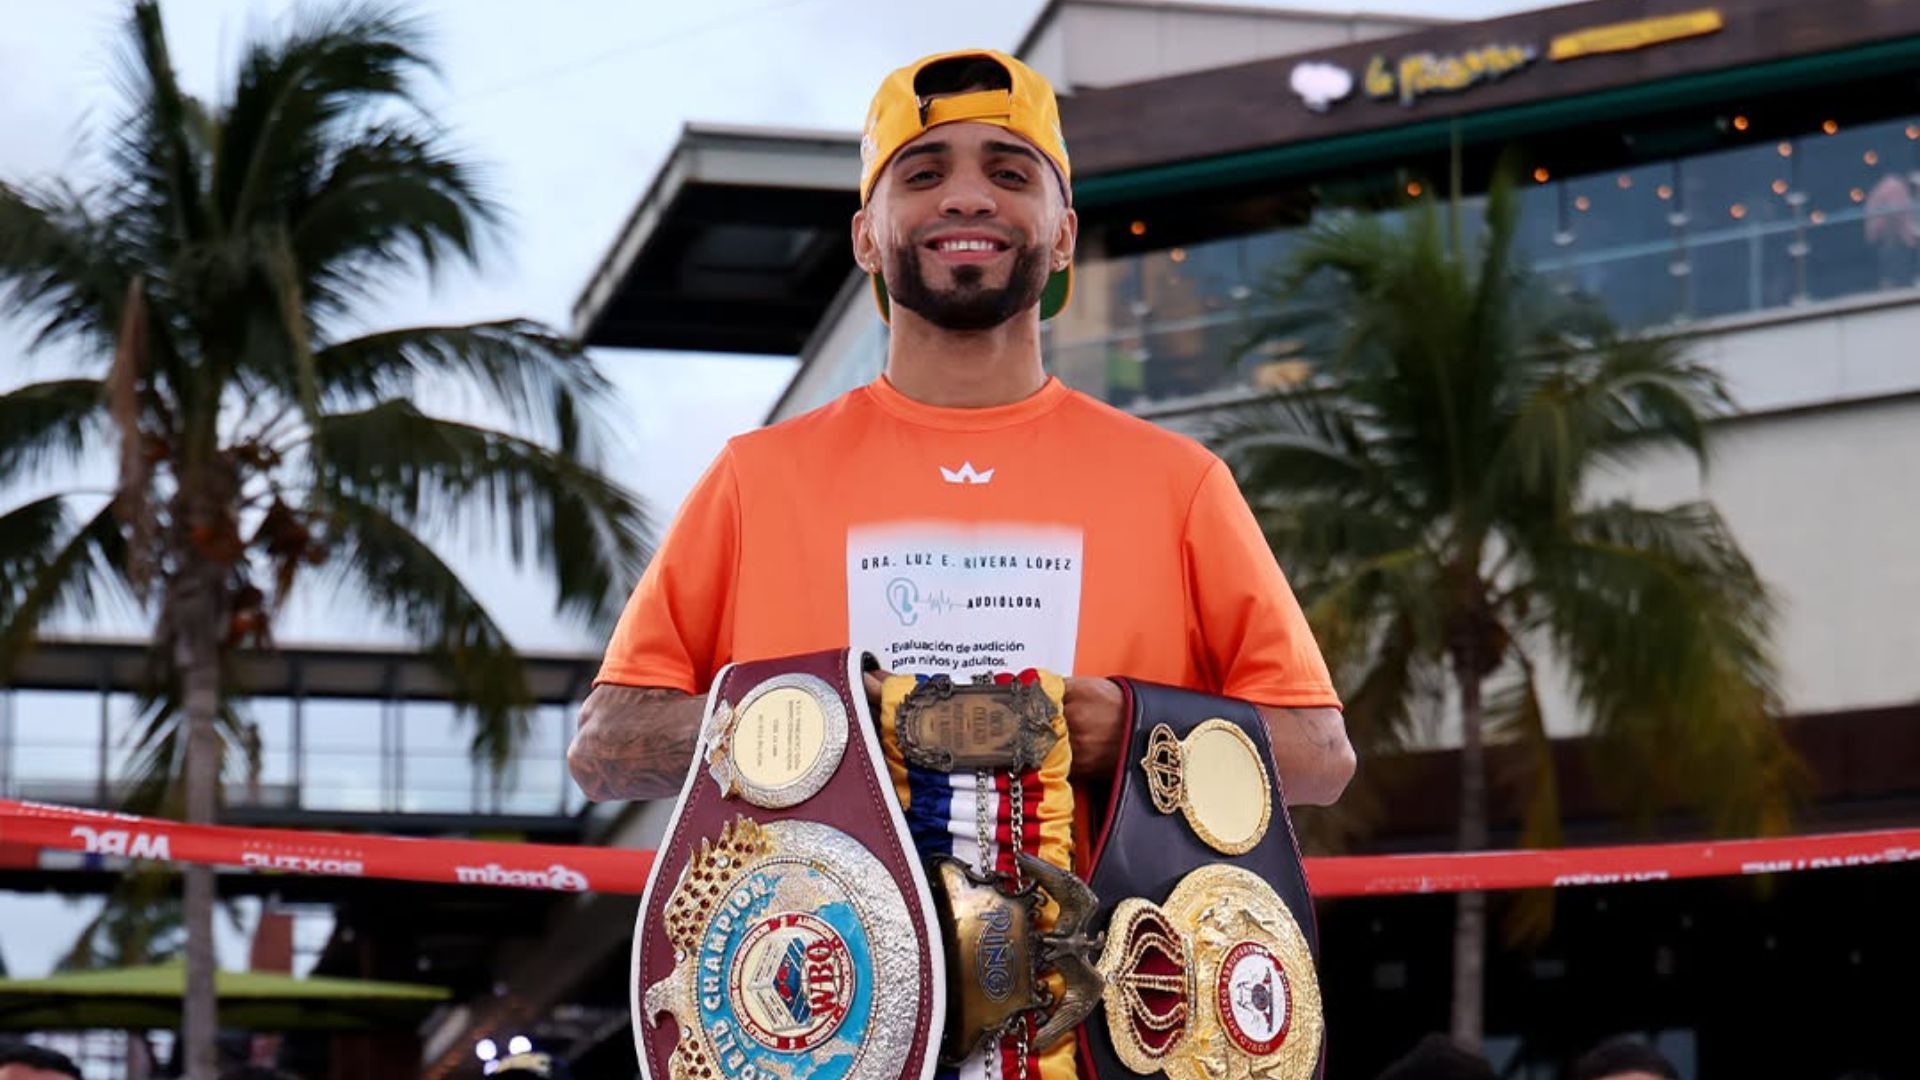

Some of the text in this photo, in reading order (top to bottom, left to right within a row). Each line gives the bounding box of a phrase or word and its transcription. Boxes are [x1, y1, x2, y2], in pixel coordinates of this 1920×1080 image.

[906, 553, 932, 565] LUZ
[964, 556, 1018, 569] RIVERA
[891, 640, 1025, 653] Evaluación de audición
[891, 655, 915, 670] para
[918, 655, 950, 666] niños
[703, 876, 771, 1011] CHAMPION
[806, 939, 837, 1017] WBO
